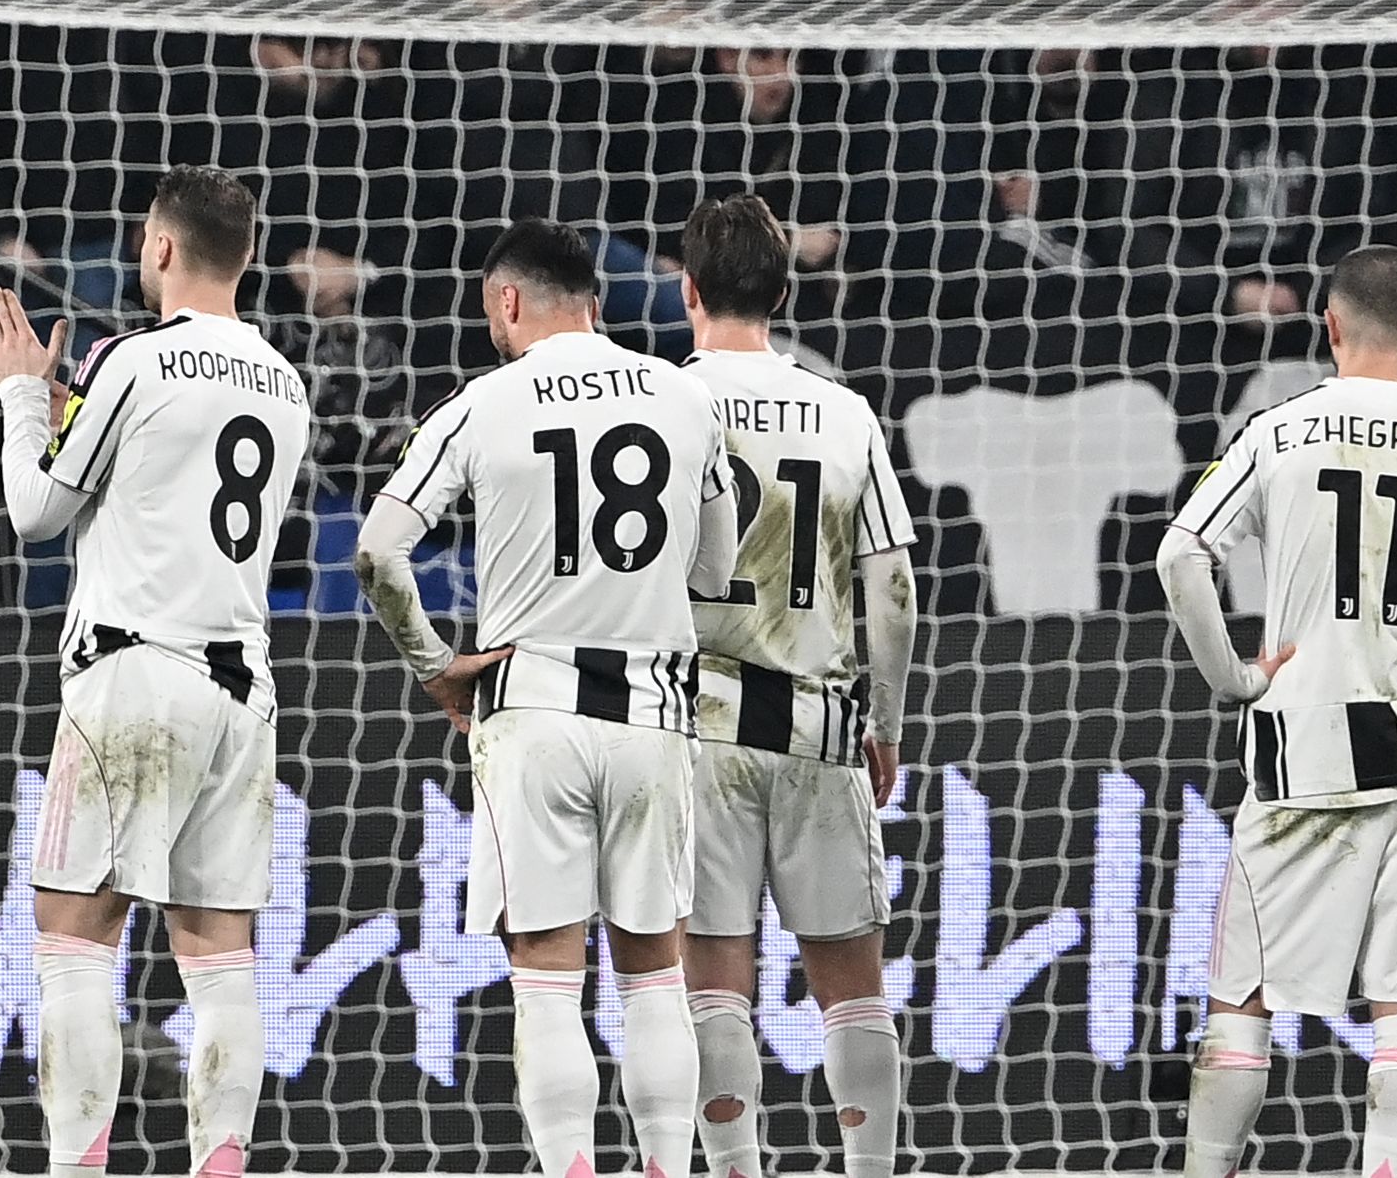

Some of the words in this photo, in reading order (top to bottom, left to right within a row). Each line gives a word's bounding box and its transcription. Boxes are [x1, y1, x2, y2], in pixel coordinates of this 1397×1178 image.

[210, 414, 275, 564] 8
[713, 397, 821, 434] IRETTI
[533, 423, 671, 577] 18
